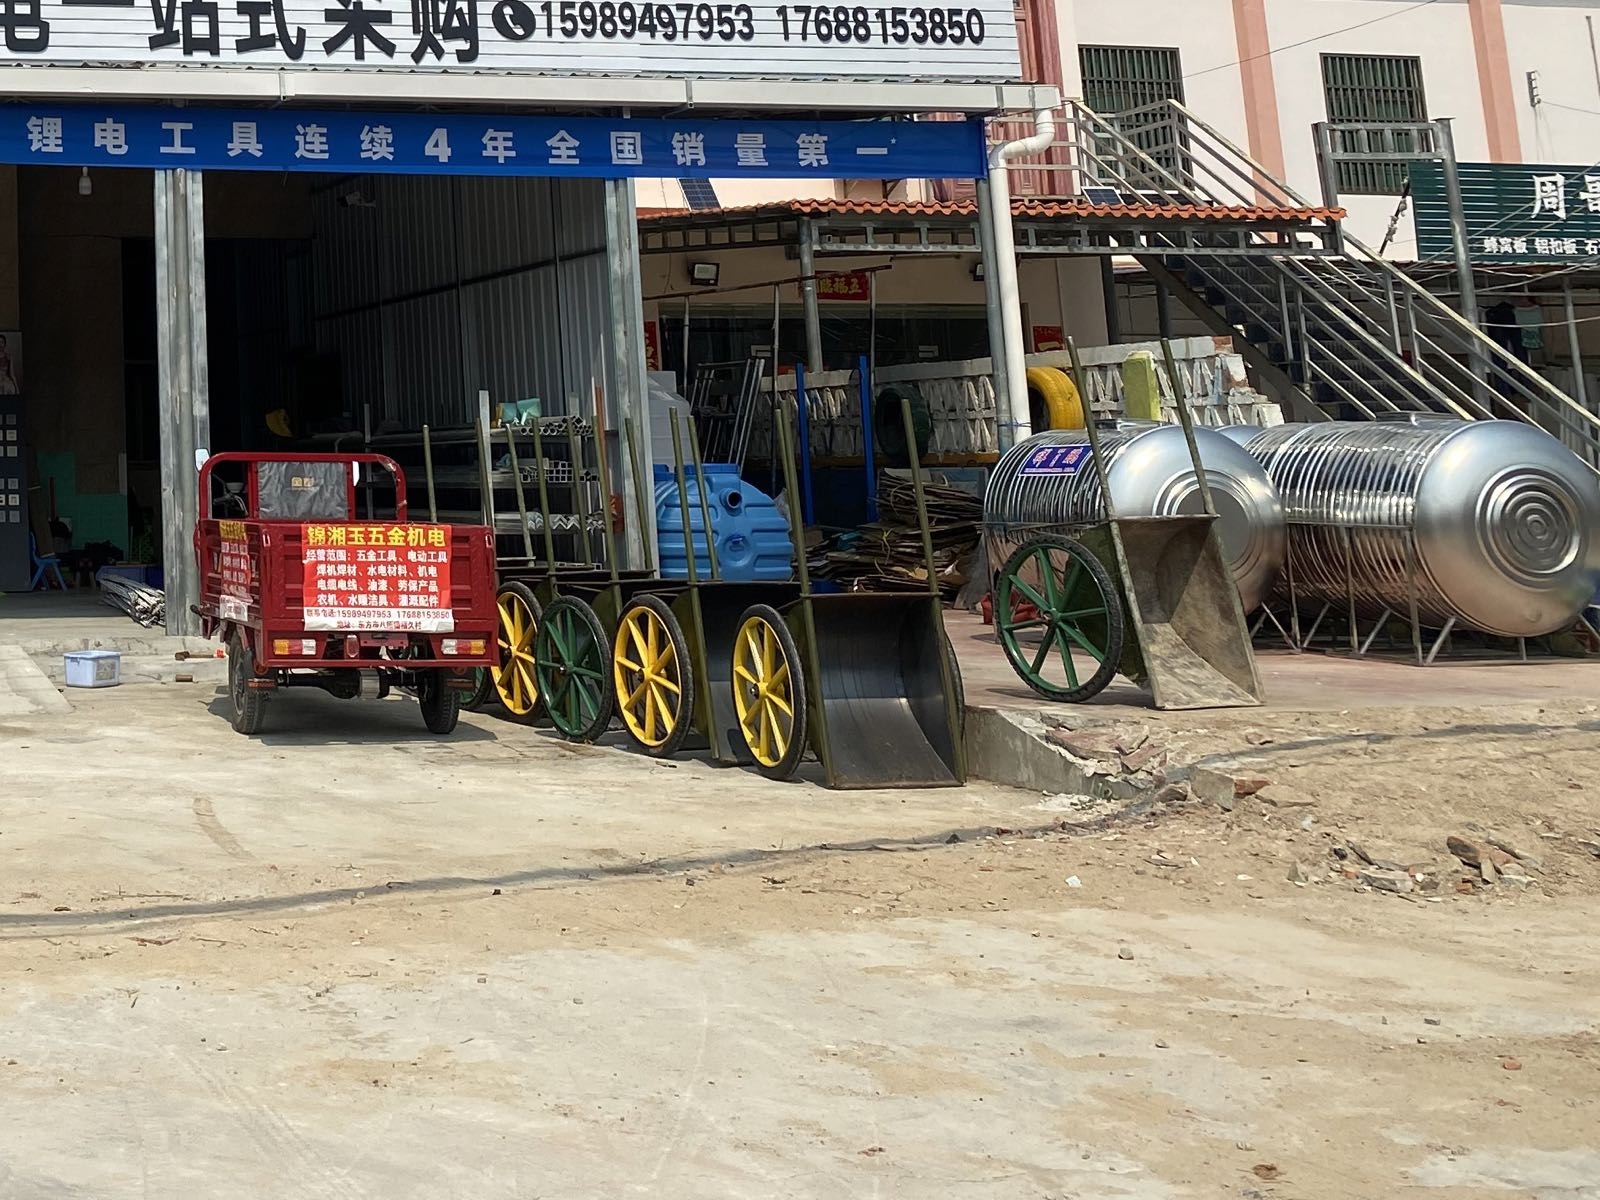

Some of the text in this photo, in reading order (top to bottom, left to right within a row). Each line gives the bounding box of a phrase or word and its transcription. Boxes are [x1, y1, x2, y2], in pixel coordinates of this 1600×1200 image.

[540, 1, 755, 41] 15989497953
[775, 4, 985, 45] 17688153850
[307, 526, 446, 547] 锦湘玉五金机电
